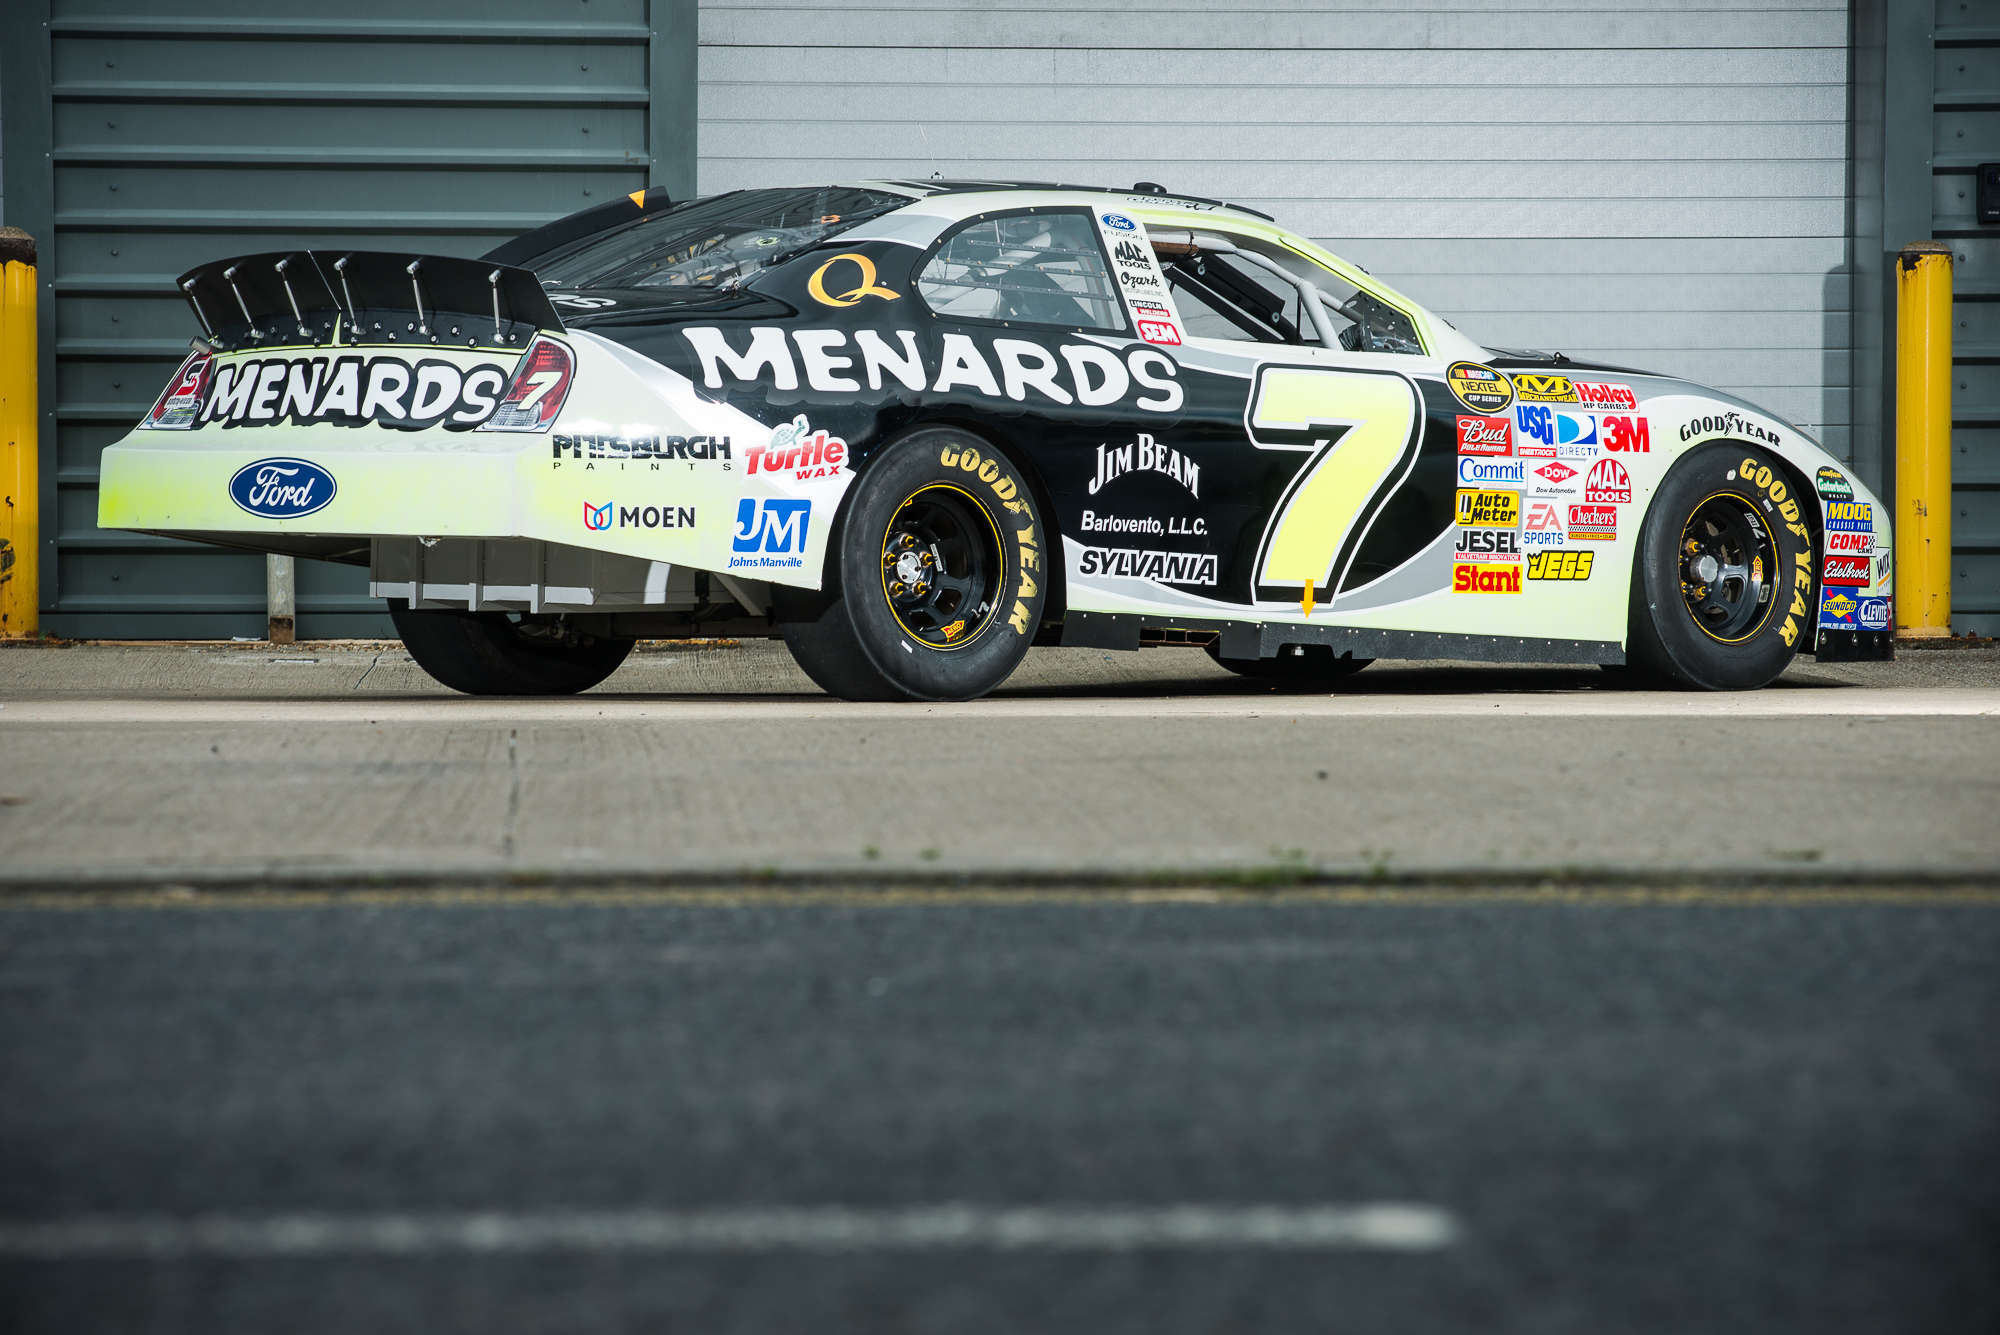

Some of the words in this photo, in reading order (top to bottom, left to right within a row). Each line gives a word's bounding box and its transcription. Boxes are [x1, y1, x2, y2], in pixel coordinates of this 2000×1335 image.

[1109, 215, 1131, 229] Ford
[1114, 241, 1149, 263] MAC
[1119, 260, 1152, 270] TOOLS
[807, 253, 901, 307] Q
[1120, 271, 1160, 288] Ozark
[1131, 300, 1163, 310] LINCOLN
[1140, 321, 1179, 342] SEM
[681, 326, 1185, 413] MENARDS
[200, 359, 503, 424] MENARDS
[516, 371, 562, 411] 7
[1461, 381, 1502, 393] NEXTEL
[1575, 383, 1636, 410] Holley
[1468, 394, 1480, 403] CUP
[1481, 395, 1502, 403] SERIES
[1598, 402, 1628, 410] CARBS
[1459, 419, 1509, 443] Bud
[1516, 405, 1555, 446] USG
[1602, 415, 1650, 453] 3M
[552, 434, 731, 460] PITTSBURGH
[745, 434, 845, 475] Turtle
[1559, 447, 1598, 457] DIRECTV
[796, 465, 840, 481] WAX
[1088, 442, 1135, 495] JIM
[1136, 432, 1201, 499] BEAM
[1459, 458, 1525, 483] Commit
[1586, 460, 1630, 490] MAC
[248, 466, 313, 509] Ford
[1246, 361, 1426, 606] 7
[1475, 493, 1511, 508] Auto
[1586, 491, 1631, 502] TOOLS
[619, 506, 696, 528] MOEN
[1471, 507, 1517, 523] Meter
[1525, 503, 1562, 531] EA
[1569, 506, 1614, 526] Checkers
[1827, 502, 1872, 521] MOOG
[733, 499, 811, 553] JM
[1081, 510, 1165, 536] Barlovento,
[1168, 516, 1208, 535] L.L.C.
[1455, 530, 1519, 553] JESEL
[1523, 532, 1564, 545] SPORTS
[1829, 533, 1869, 550] COMP
[728, 557, 759, 569] Johns
[759, 557, 802, 568] Manville
[1079, 548, 1216, 582] SYLVANIA
[1527, 549, 1595, 581] JEGS
[1824, 560, 1869, 581] Edelbrock
[1454, 565, 1520, 592] Stant
[1824, 601, 1856, 611] SUNOCO
